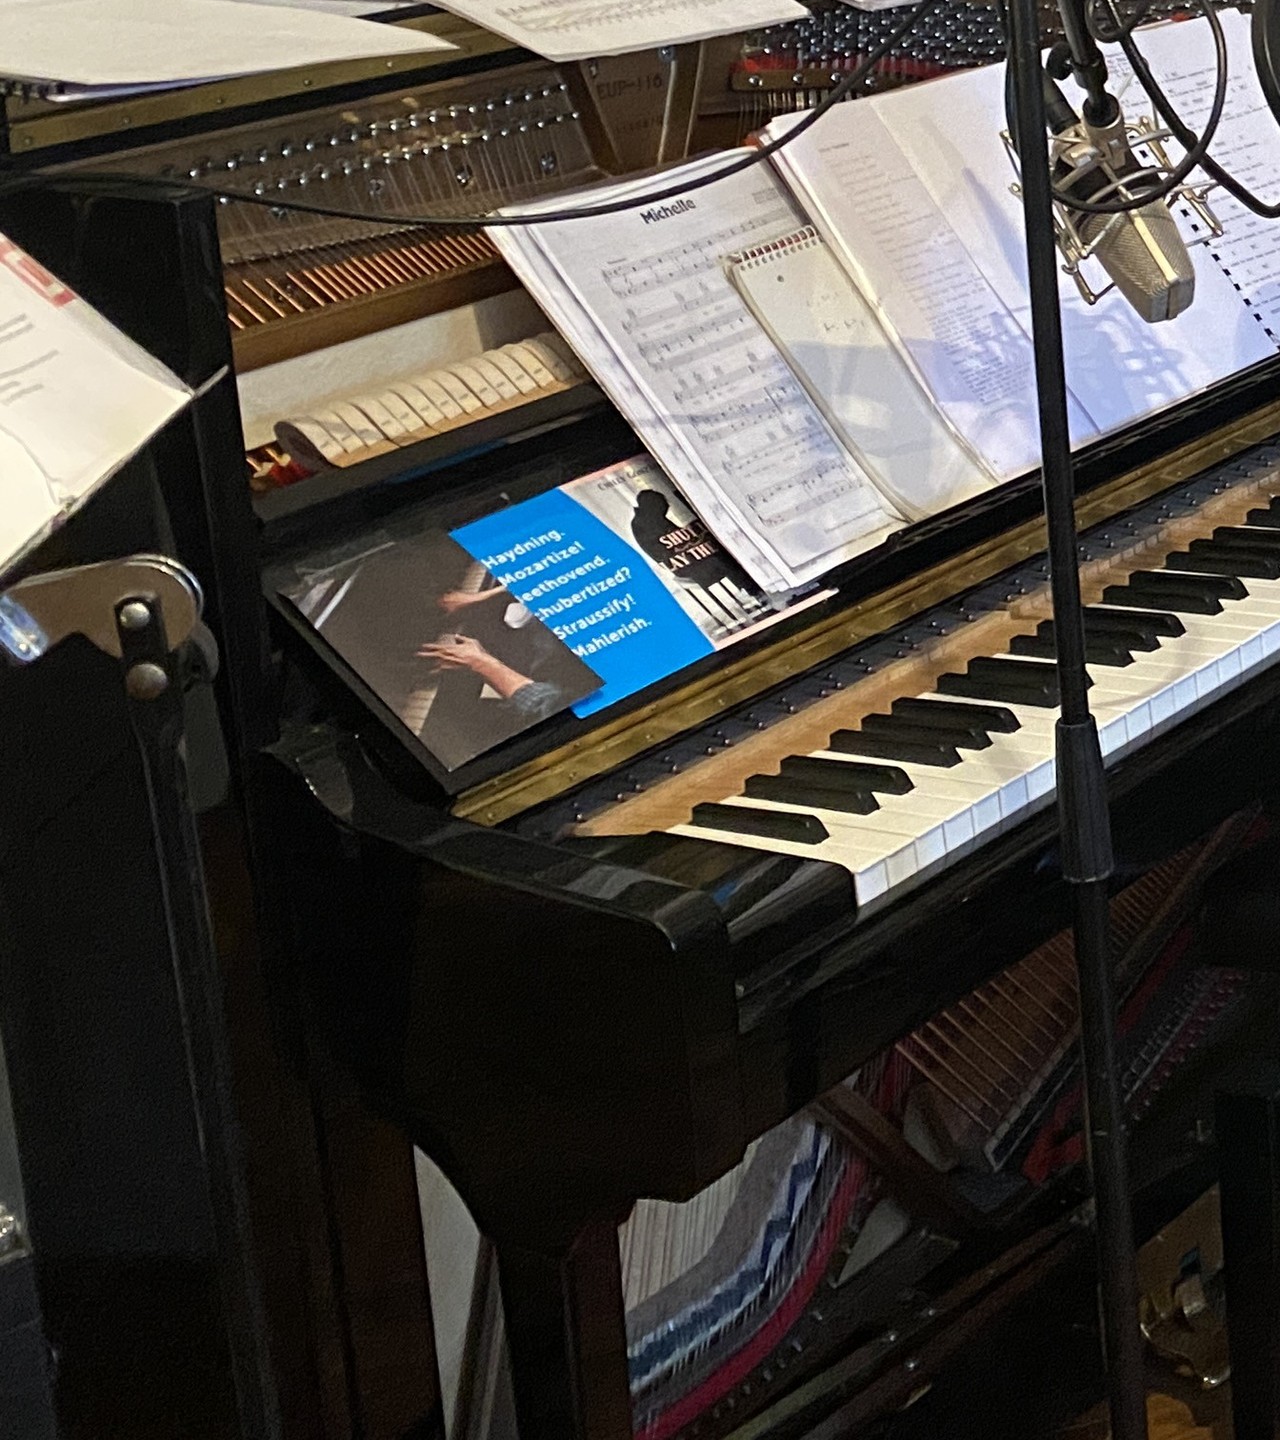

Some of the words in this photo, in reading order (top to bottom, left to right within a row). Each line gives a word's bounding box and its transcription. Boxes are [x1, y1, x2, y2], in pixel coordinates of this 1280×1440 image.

[640, 199, 697, 224] Michelle
[481, 529, 566, 570] Haydning.
[659, 526, 699, 550] SHUT
[497, 540, 586, 587] Mozartize!
[516, 555, 611, 603] eethovend.
[553, 592, 638, 641] Straussify!
